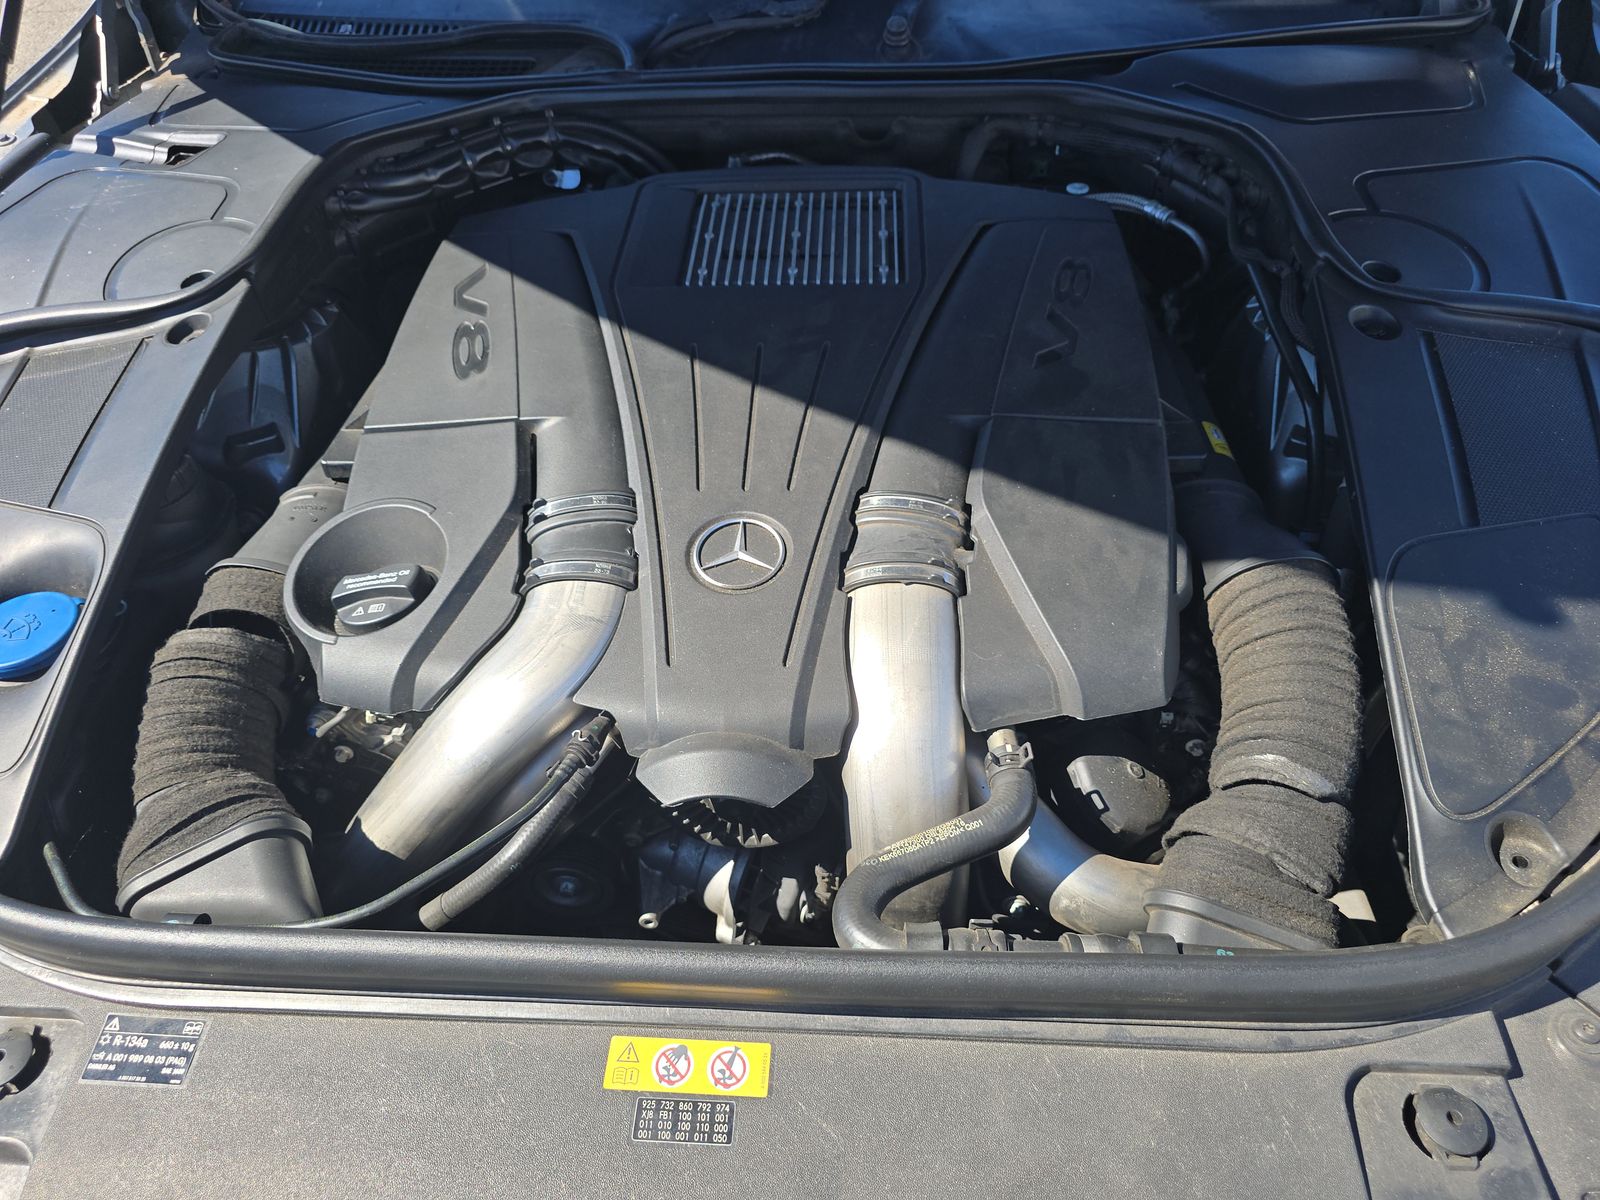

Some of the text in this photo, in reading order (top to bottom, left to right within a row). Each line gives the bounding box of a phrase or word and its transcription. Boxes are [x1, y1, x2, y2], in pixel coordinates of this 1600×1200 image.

[1031, 256, 1095, 369] V8
[452, 261, 491, 381] V8
[112, 1035, 149, 1048] R-134a
[104, 1053, 112, 1061] A
[112, 1053, 128, 1062] 001
[154, 1056, 166, 1065] 03
[165, 1056, 187, 1067] (PAG)
[642, 1099, 730, 1112] 925 732 860 792 974
[641, 1110, 729, 1122] XJ8 FB1 100 101 001
[639, 1119, 728, 1133] 011 010 100 110 000
[638, 1130, 727, 1143] 001 100 001 011 050
